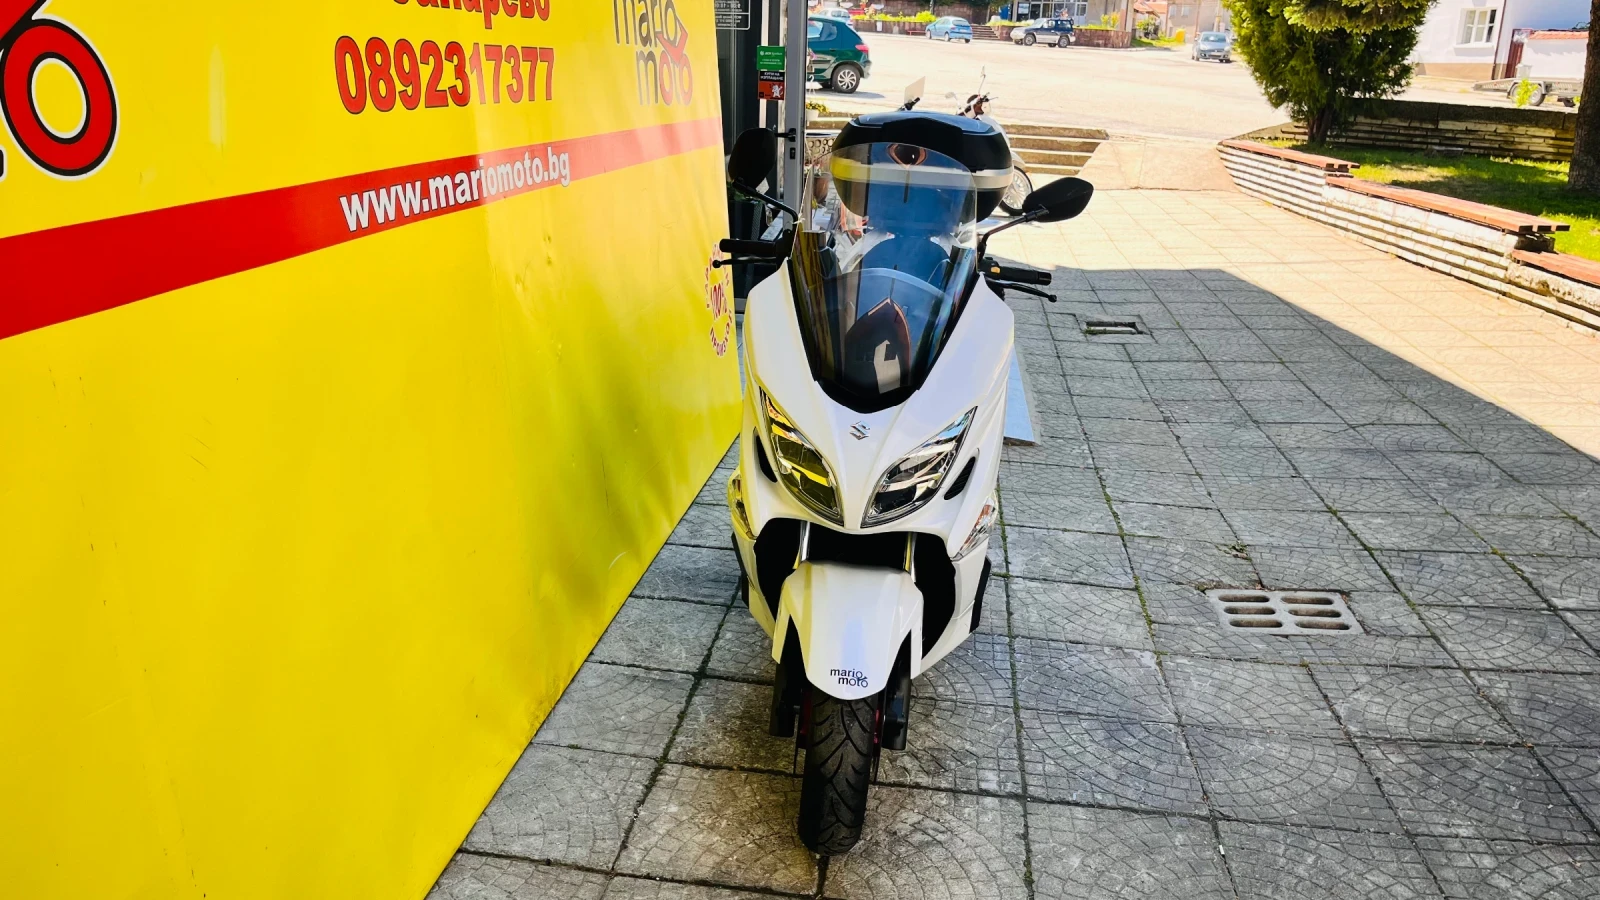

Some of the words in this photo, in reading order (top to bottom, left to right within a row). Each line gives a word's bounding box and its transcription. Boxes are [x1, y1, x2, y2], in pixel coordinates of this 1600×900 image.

[335, 35, 554, 115] 0892317377
[636, 50, 693, 106] moto
[339, 146, 571, 232] www.mariomoto.bg
[830, 668, 863, 679] mario
[838, 676, 869, 688] moto
